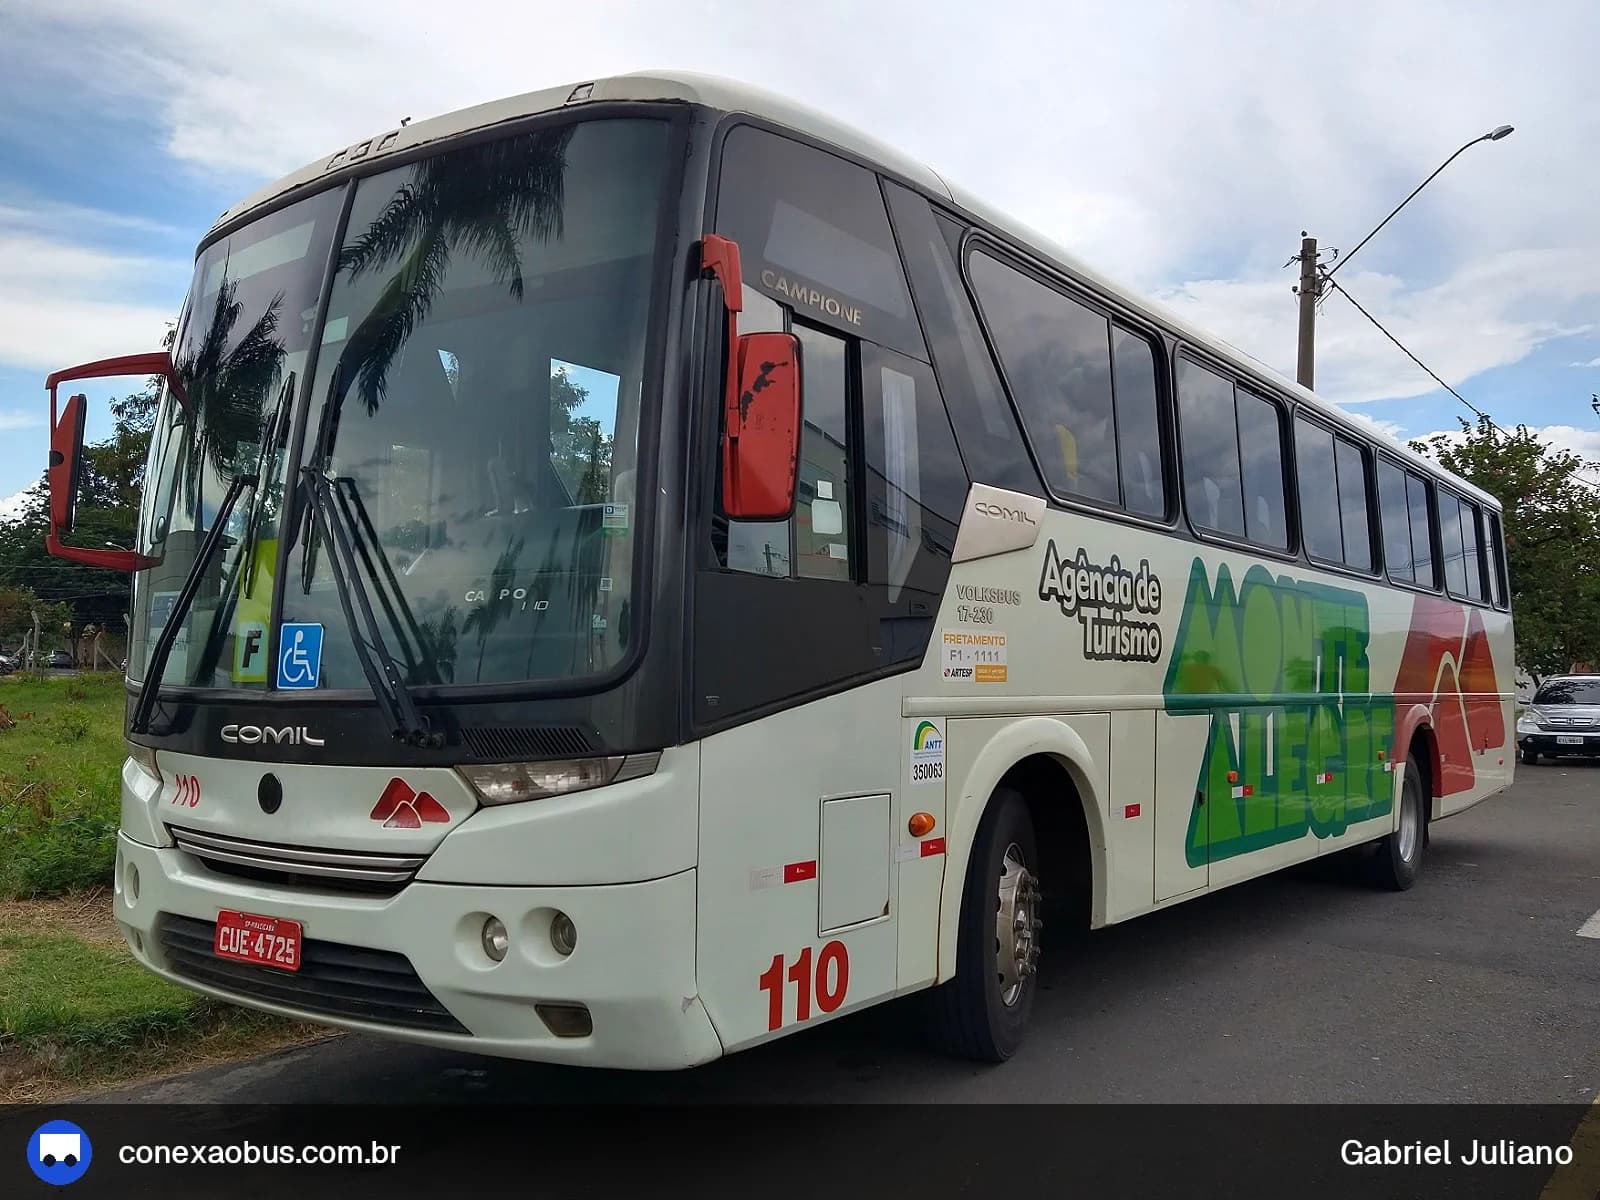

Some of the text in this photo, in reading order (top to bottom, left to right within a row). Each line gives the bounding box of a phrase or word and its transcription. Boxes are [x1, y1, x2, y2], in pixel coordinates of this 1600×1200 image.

[762, 270, 862, 325] CAMPIONE
[975, 502, 1036, 525] COMIL
[1040, 541, 1161, 615] Agência de
[956, 584, 1021, 605] VOLKSBUS
[957, 605, 993, 624] 17-230
[943, 633, 1006, 646] FRETAMENTO
[1078, 607, 1161, 662] Turismo
[1163, 557, 1370, 712] MONTE
[242, 630, 262, 668] F
[974, 650, 999, 662] 1111
[951, 668, 973, 678] ARTESP
[220, 724, 325, 746] COMIL
[925, 739, 942, 750] ANTT
[913, 762, 943, 780] 350063
[171, 773, 201, 808] 110
[1185, 698, 1395, 868] ALEGRE
[759, 939, 849, 1032] 110
